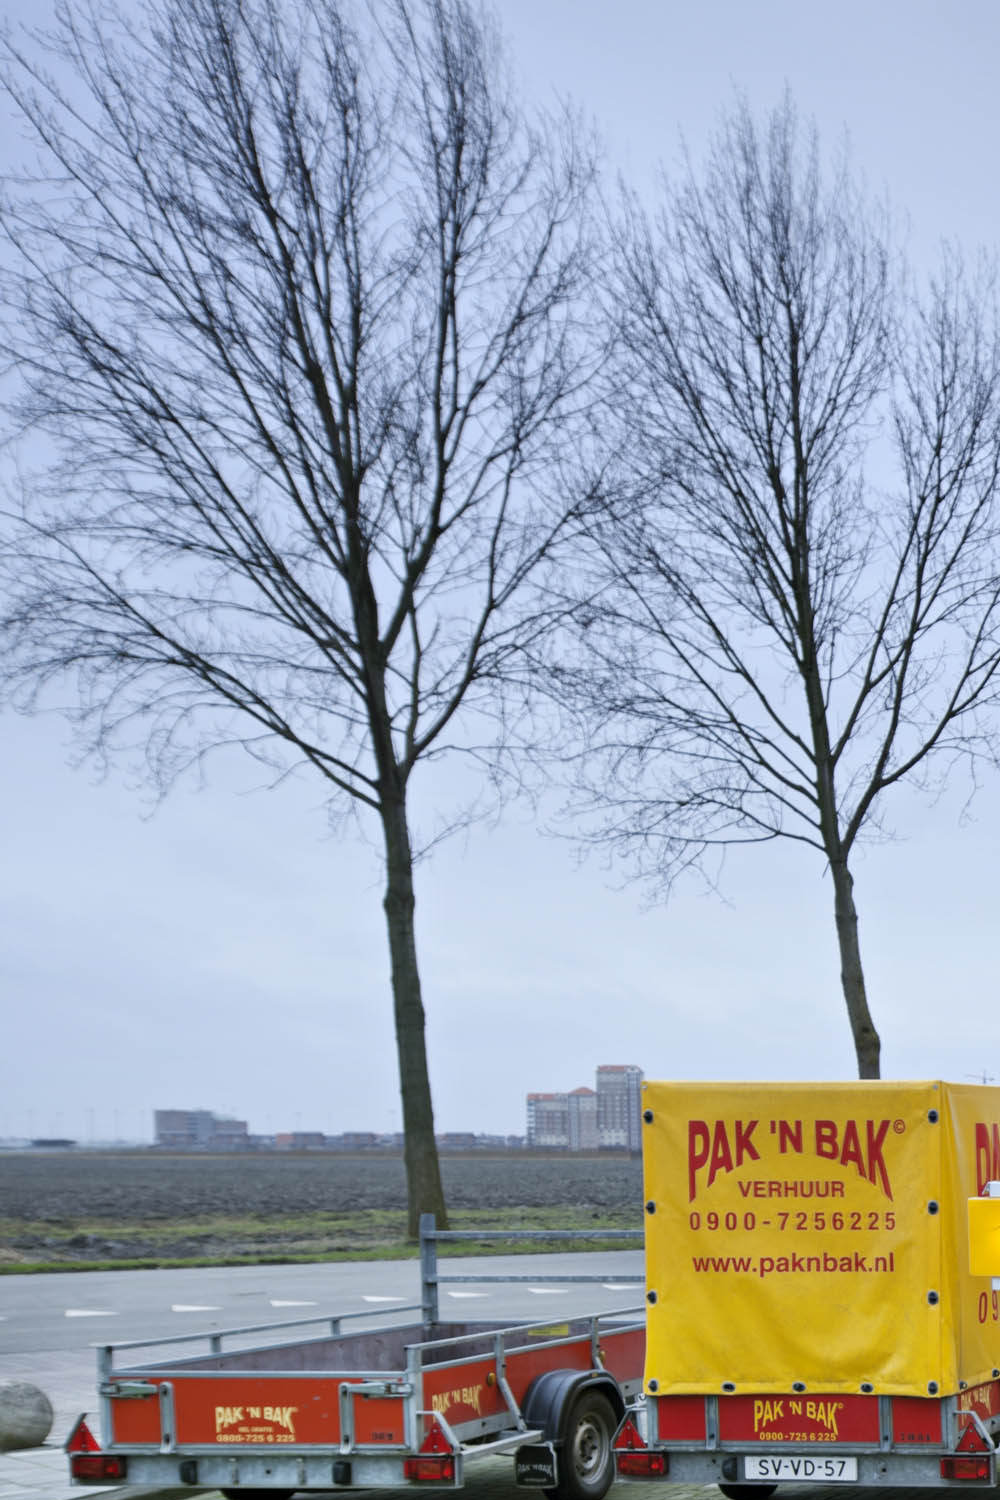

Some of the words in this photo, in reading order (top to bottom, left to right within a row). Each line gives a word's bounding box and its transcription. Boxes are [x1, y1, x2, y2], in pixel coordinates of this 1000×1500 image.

[689, 1120, 761, 1203] PAK
[769, 1120, 803, 1154] 'N
[814, 1120, 894, 1202] BAK
[737, 1181, 845, 1198] VERHUUR
[689, 1211, 896, 1231] 0900-7256225
[692, 1252, 895, 1278] www.paknbak.nl
[215, 1406, 244, 1433] PAK
[263, 1406, 296, 1433] BAK
[754, 1400, 784, 1433] PAK
[806, 1402, 839, 1435] BAK
[758, 1459, 846, 1477] SV-VD-57
